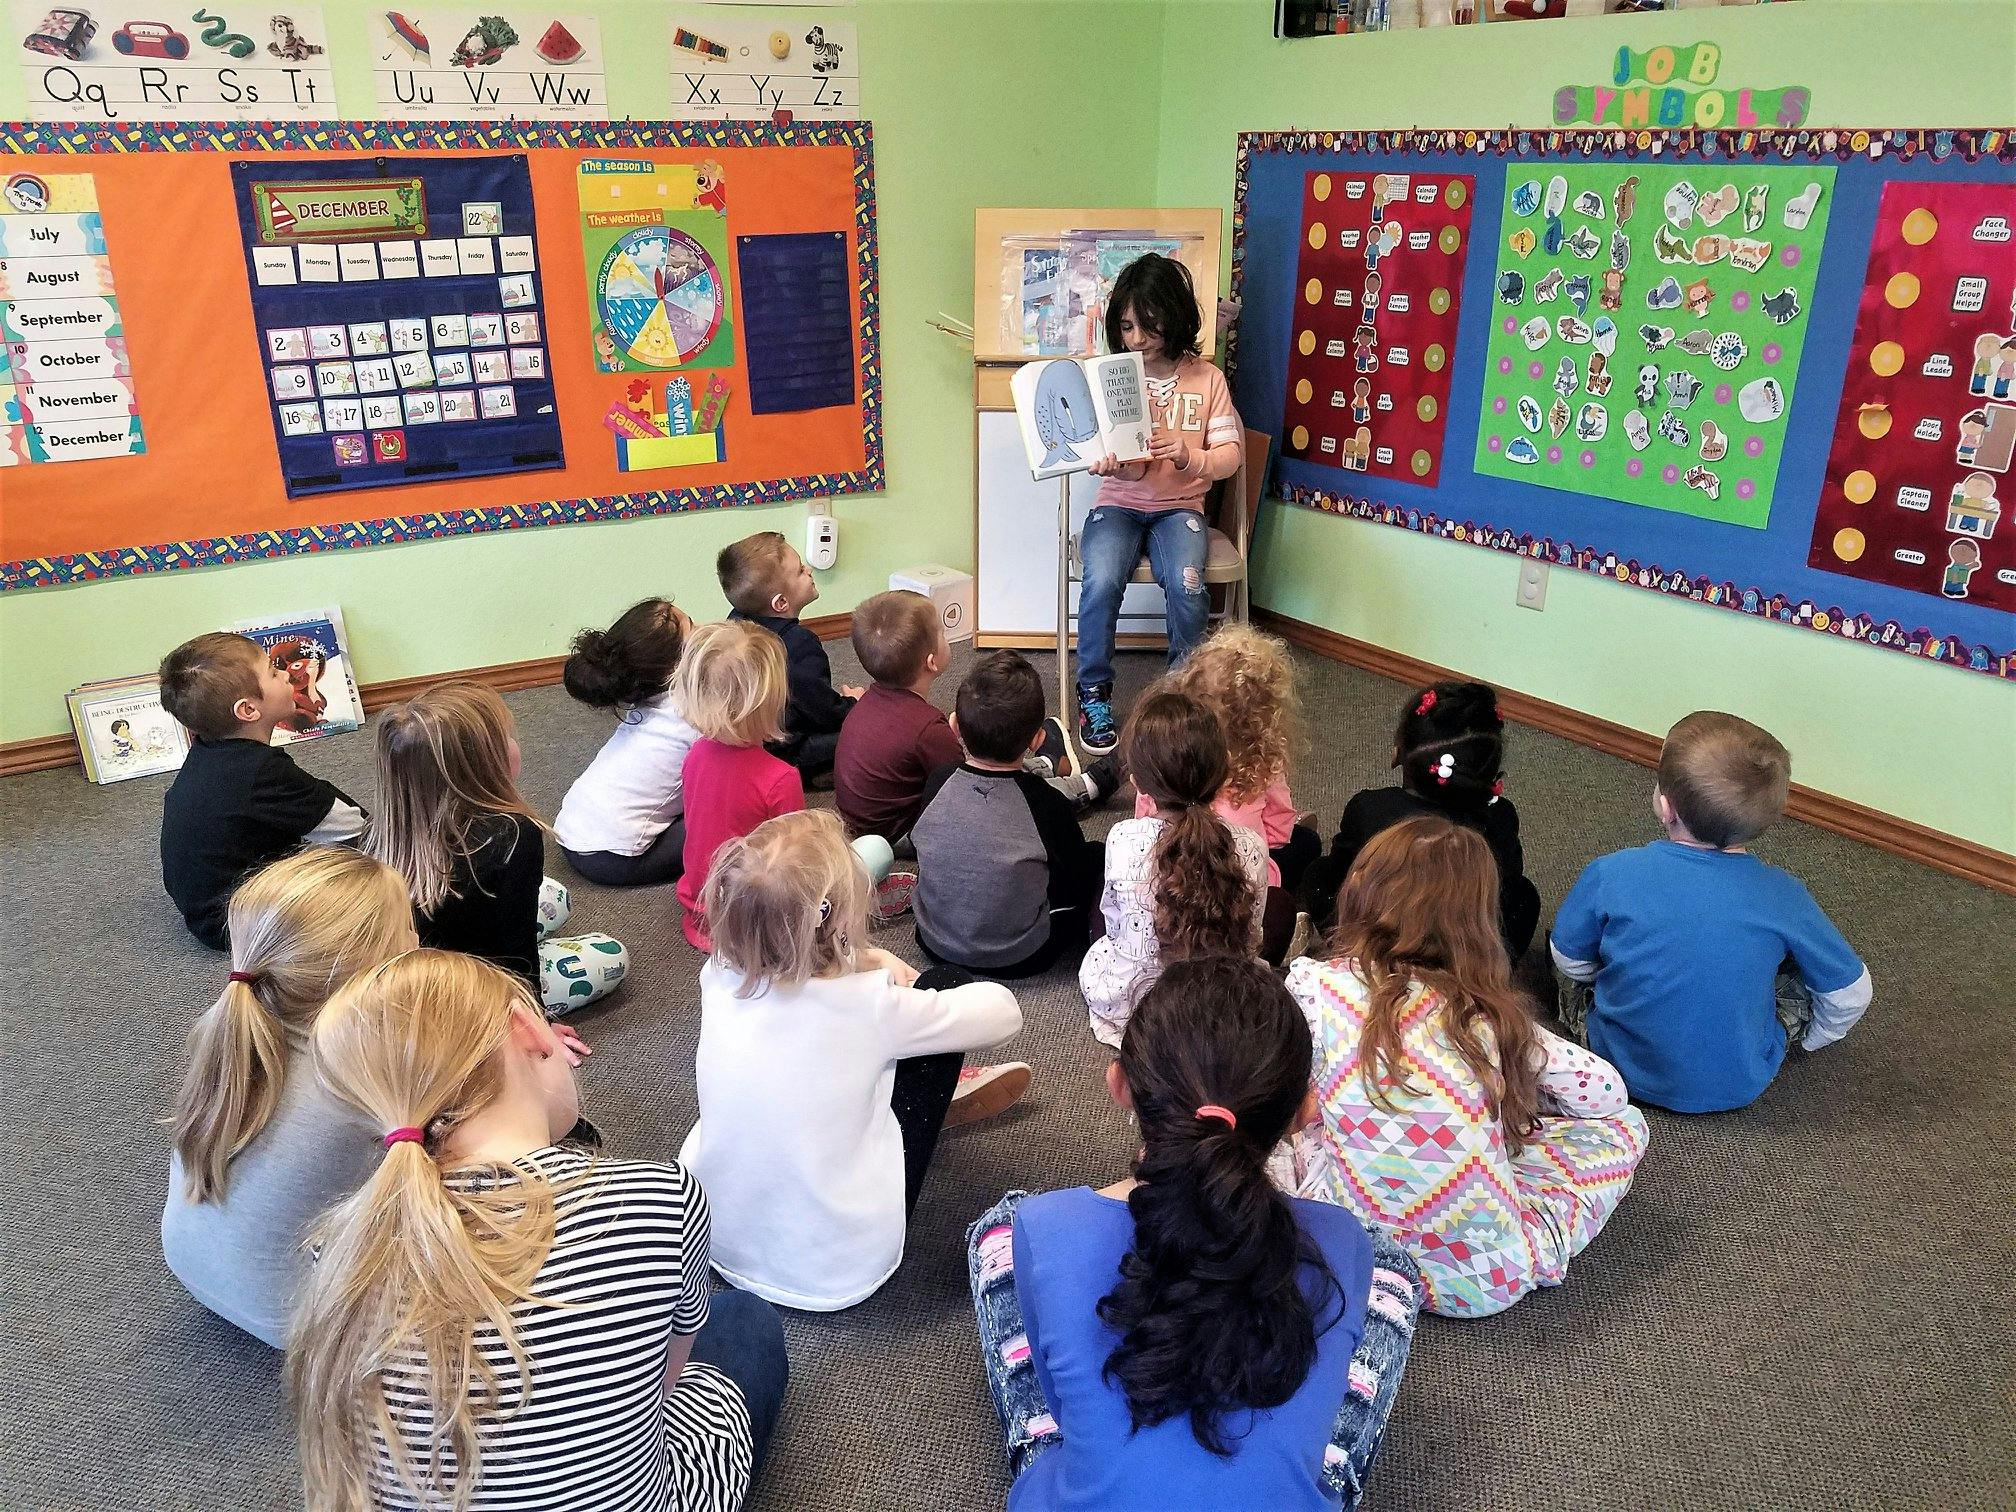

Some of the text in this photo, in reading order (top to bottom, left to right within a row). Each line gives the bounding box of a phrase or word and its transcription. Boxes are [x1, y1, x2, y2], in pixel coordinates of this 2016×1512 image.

[1614, 44, 1721, 86] JOB
[44, 66, 316, 117] Qq Rr Ss Tt
[393, 71, 591, 104] Uu Vv Ww
[685, 74, 843, 112] Xx Yy Zz
[1556, 86, 1810, 128] SYMBOLS
[584, 160, 652, 172] The season is
[297, 200, 389, 219] DECEMBER
[468, 212, 482, 226] 22
[588, 211, 662, 226] The weather is
[1985, 220, 2004, 228] Face
[29, 227, 60, 244] July
[632, 227, 654, 239] cloudy
[1975, 229, 2009, 238] Changer
[684, 236, 704, 255] stormy
[427, 254, 453, 262] Thursday
[467, 252, 485, 260] Friday
[0, 262, 8, 271] 8
[598, 250, 618, 295] partly cloudy
[26, 271, 80, 286] August
[1961, 280, 1983, 289] Small
[519, 284, 528, 298] 1
[1958, 290, 1981, 299] Group
[8, 303, 16, 313] 9
[1955, 299, 1981, 308] Helper
[20, 311, 103, 329] September
[604, 318, 618, 336] rainy
[274, 322, 521, 351] 2 3 4 5 6 7 8
[14, 345, 25, 354] 10
[693, 337, 710, 354] windy
[40, 353, 101, 367] October
[1931, 357, 1948, 365] Line
[294, 356, 539, 388] 9 10 11 12 13 14 15
[1120, 366, 1130, 374] BIG
[1925, 366, 1951, 375] Leader
[1106, 378, 1125, 387] THAT
[25, 386, 35, 395] 11
[1106, 387, 1137, 398] ONE WILL
[39, 392, 119, 408] November
[1117, 397, 1132, 407] PLAY
[285, 394, 511, 425] 16 17 18 19 20 21
[1111, 408, 1130, 418] WITH
[33, 426, 44, 435] 12
[1922, 420, 1939, 429] Door
[50, 431, 124, 447] December
[1916, 428, 1940, 439] Holder
[1901, 489, 1930, 500] Captain
[1900, 497, 1927, 508] Cleaner
[1896, 551, 1924, 562] Greeter
[262, 634, 300, 647] Mine,
[91, 708, 114, 719] BEING
